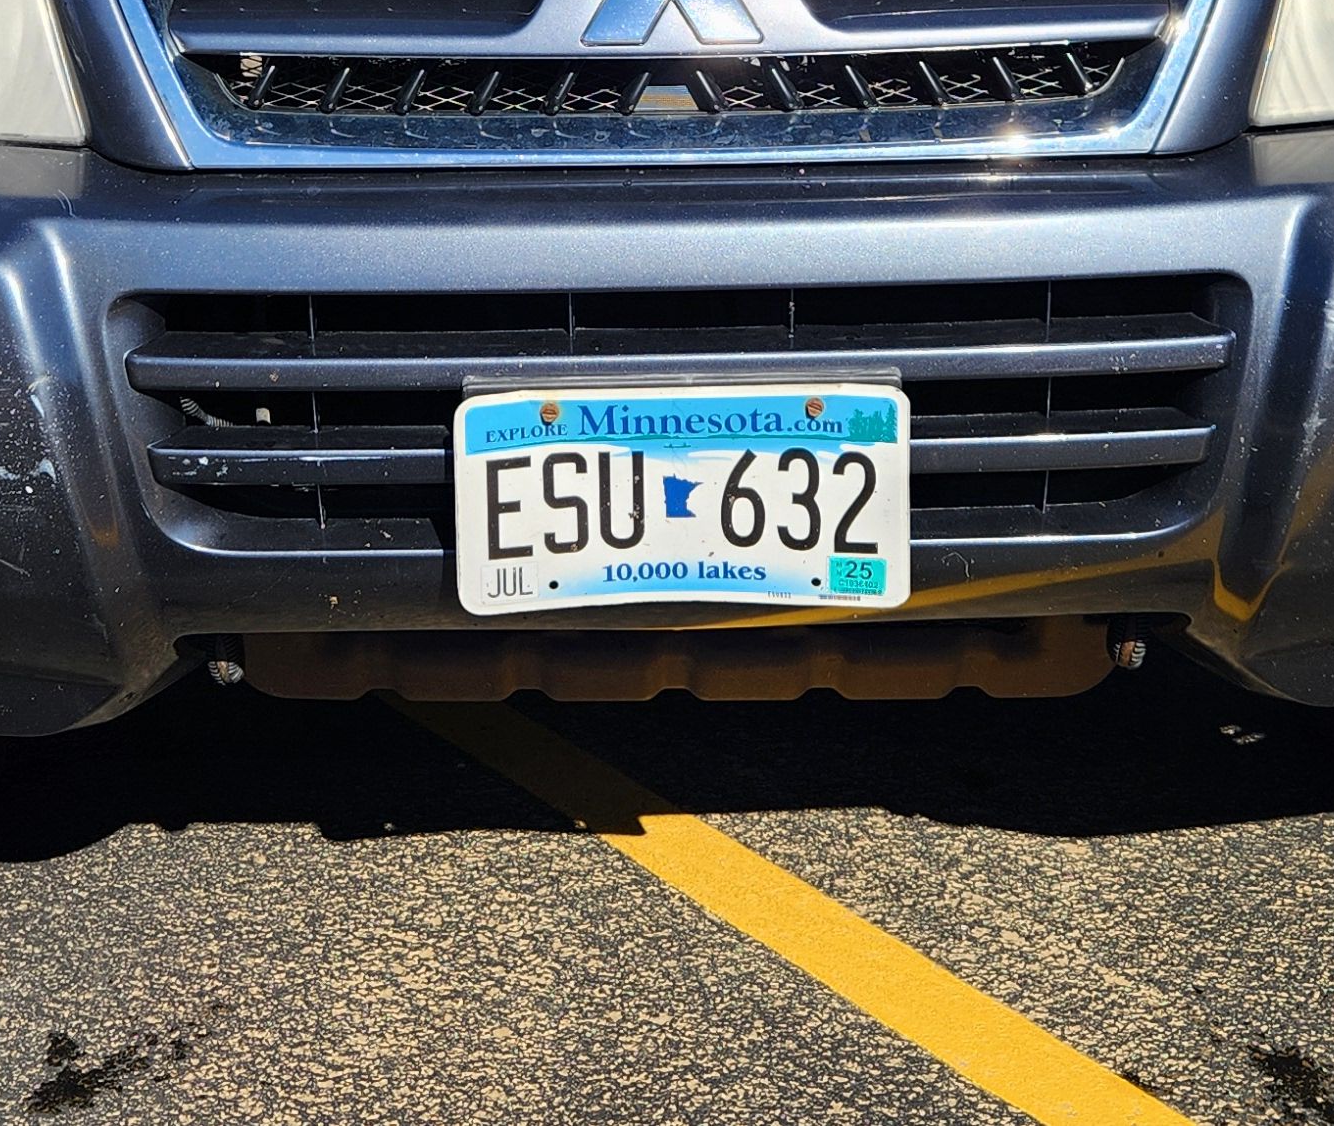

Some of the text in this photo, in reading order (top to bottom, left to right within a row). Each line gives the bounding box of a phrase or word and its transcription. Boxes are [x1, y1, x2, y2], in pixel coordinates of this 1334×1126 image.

[485, 404, 843, 443] EXPLORE Minnesota.com
[486, 447, 878, 560] ESU 632
[487, 566, 534, 598] JUL
[602, 561, 767, 583] 10,000 lakes
[844, 560, 873, 580] 25
